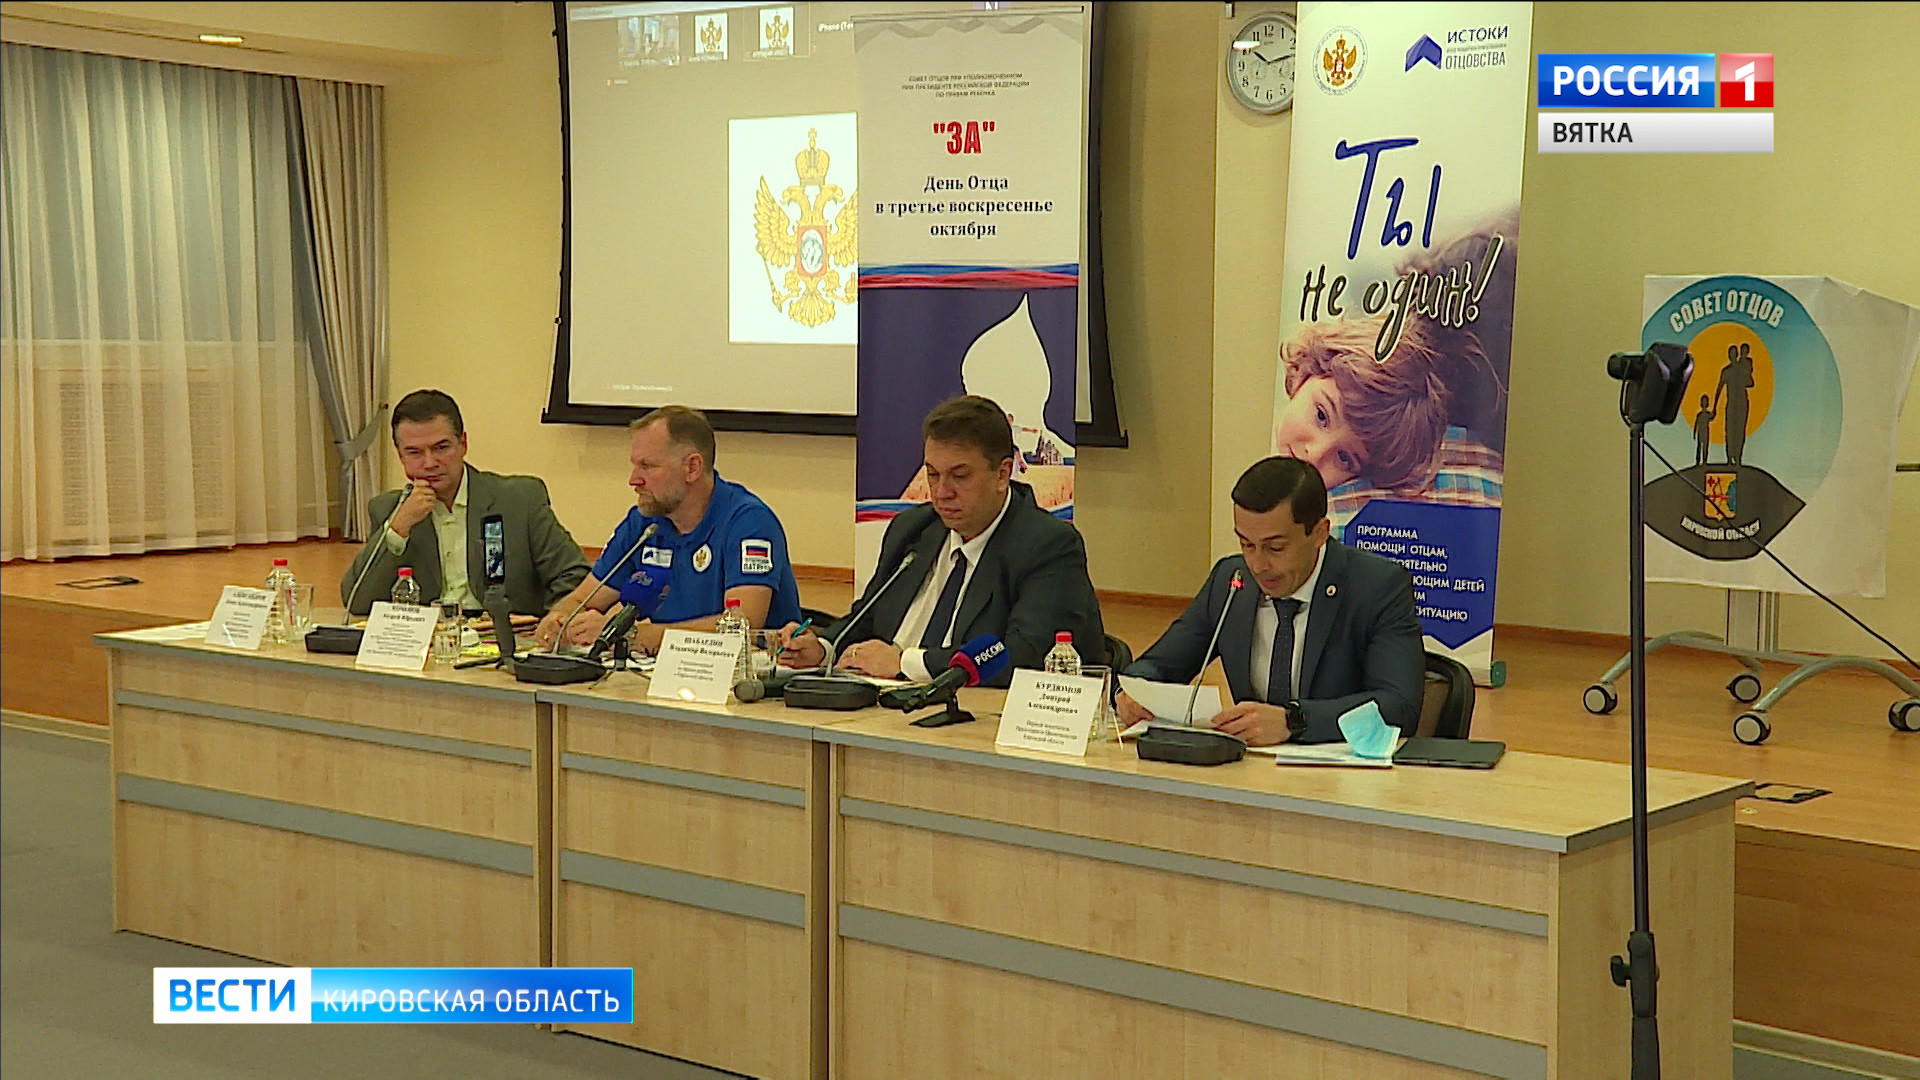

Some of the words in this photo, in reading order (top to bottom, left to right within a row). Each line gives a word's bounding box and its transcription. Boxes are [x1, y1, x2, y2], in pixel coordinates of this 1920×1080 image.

[1264, 24, 1274, 37] 12
[1447, 25, 1508, 44] ИСТОКИ
[1445, 51, 1506, 70] ОТЦОВСТВА
[933, 121, 996, 154] "ЗА"
[924, 175, 964, 193] День
[968, 175, 1009, 192] Отца
[875, 202, 884, 214] в
[888, 202, 946, 217] третье
[949, 200, 1053, 216] воскресенье
[930, 221, 997, 240] октября
[1669, 291, 1722, 333] СОВЕТ
[1726, 289, 1784, 328] ОТЦОВ
[1357, 525, 1418, 540] ПРОГРАММА
[1356, 540, 1405, 555] ПОМОЩИ
[1410, 545, 1448, 560] ОТЦАМ,
[1453, 579, 1485, 592] ДЕТЕЙ
